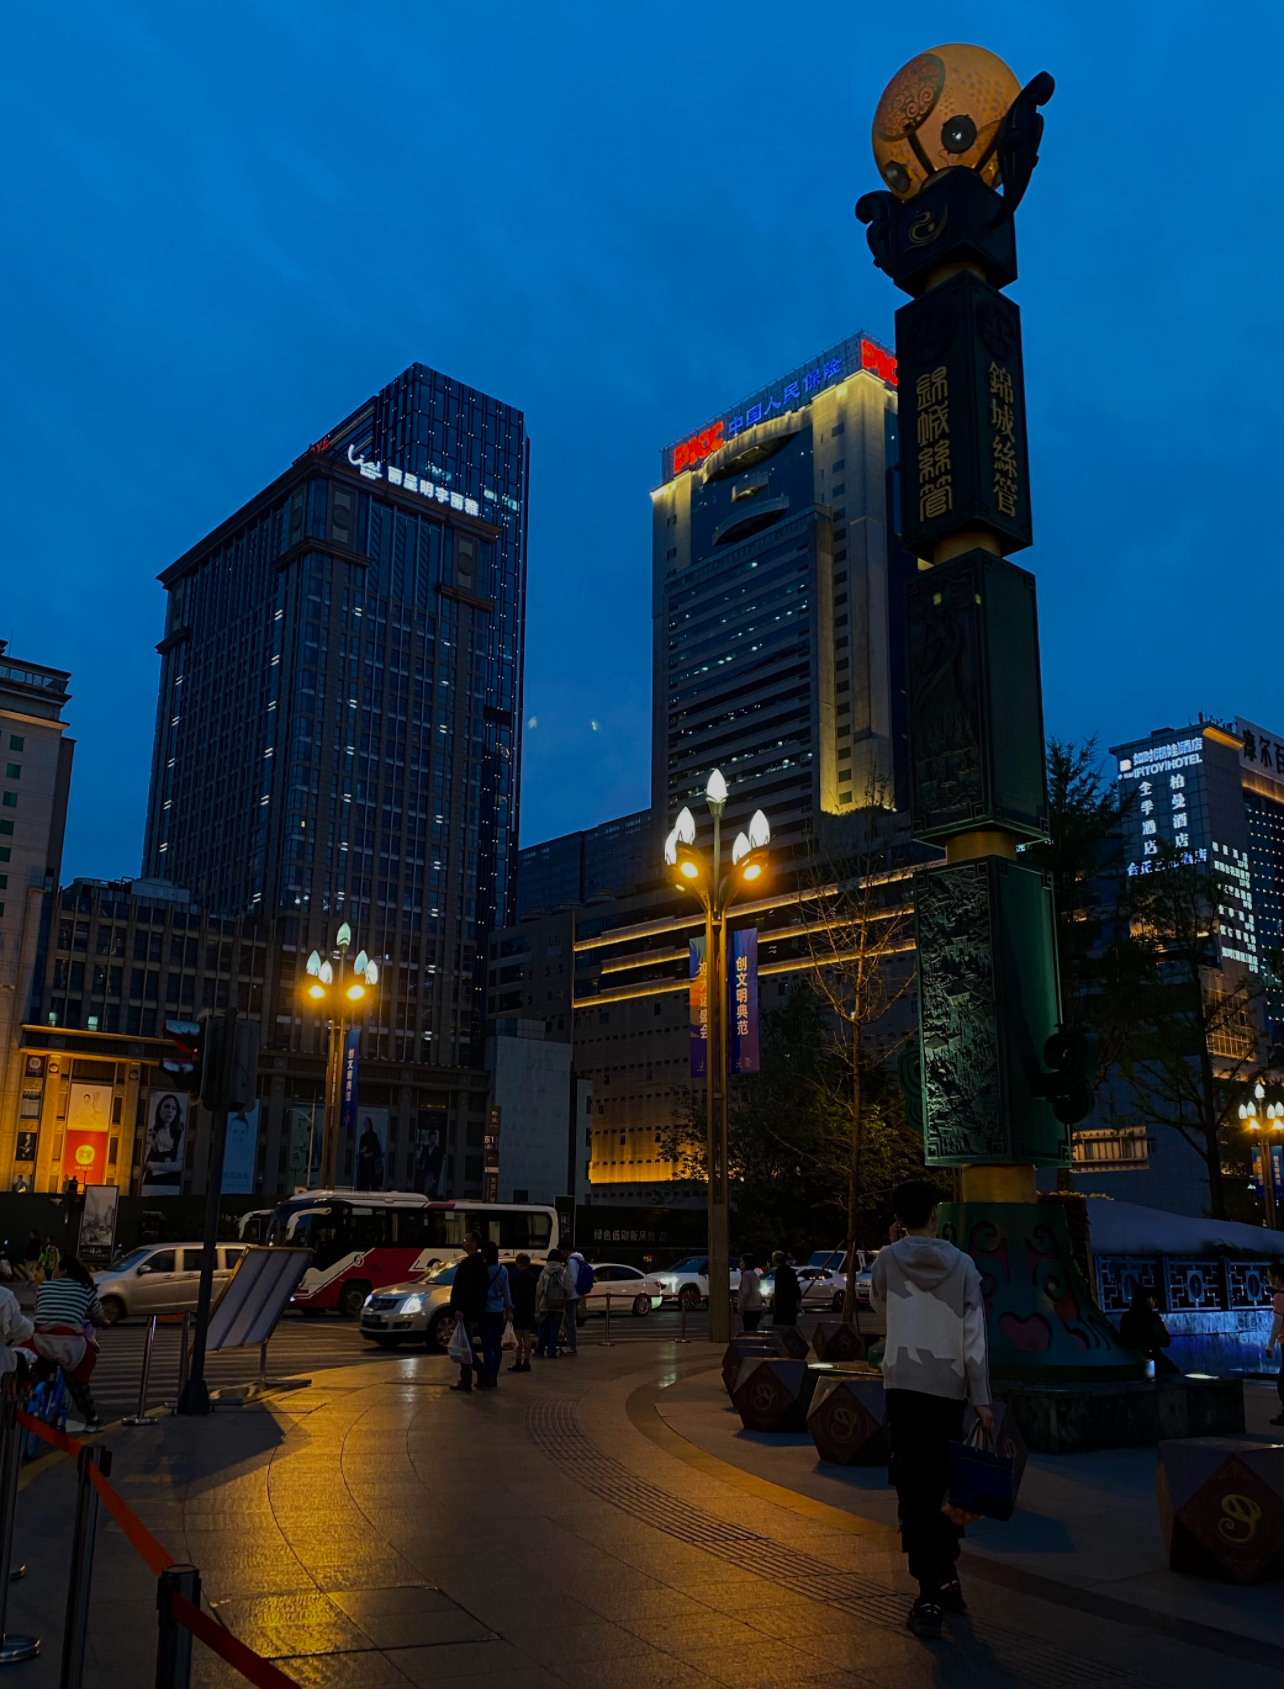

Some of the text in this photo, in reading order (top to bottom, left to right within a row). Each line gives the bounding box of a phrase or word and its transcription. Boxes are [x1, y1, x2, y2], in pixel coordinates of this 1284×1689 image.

[728, 357, 843, 435] 中国人民保险
[1138, 780, 1158, 856] 全季酒店
[1169, 773, 1190, 849] 柏曼酒店
[736, 956, 749, 1036] 创文明典范
